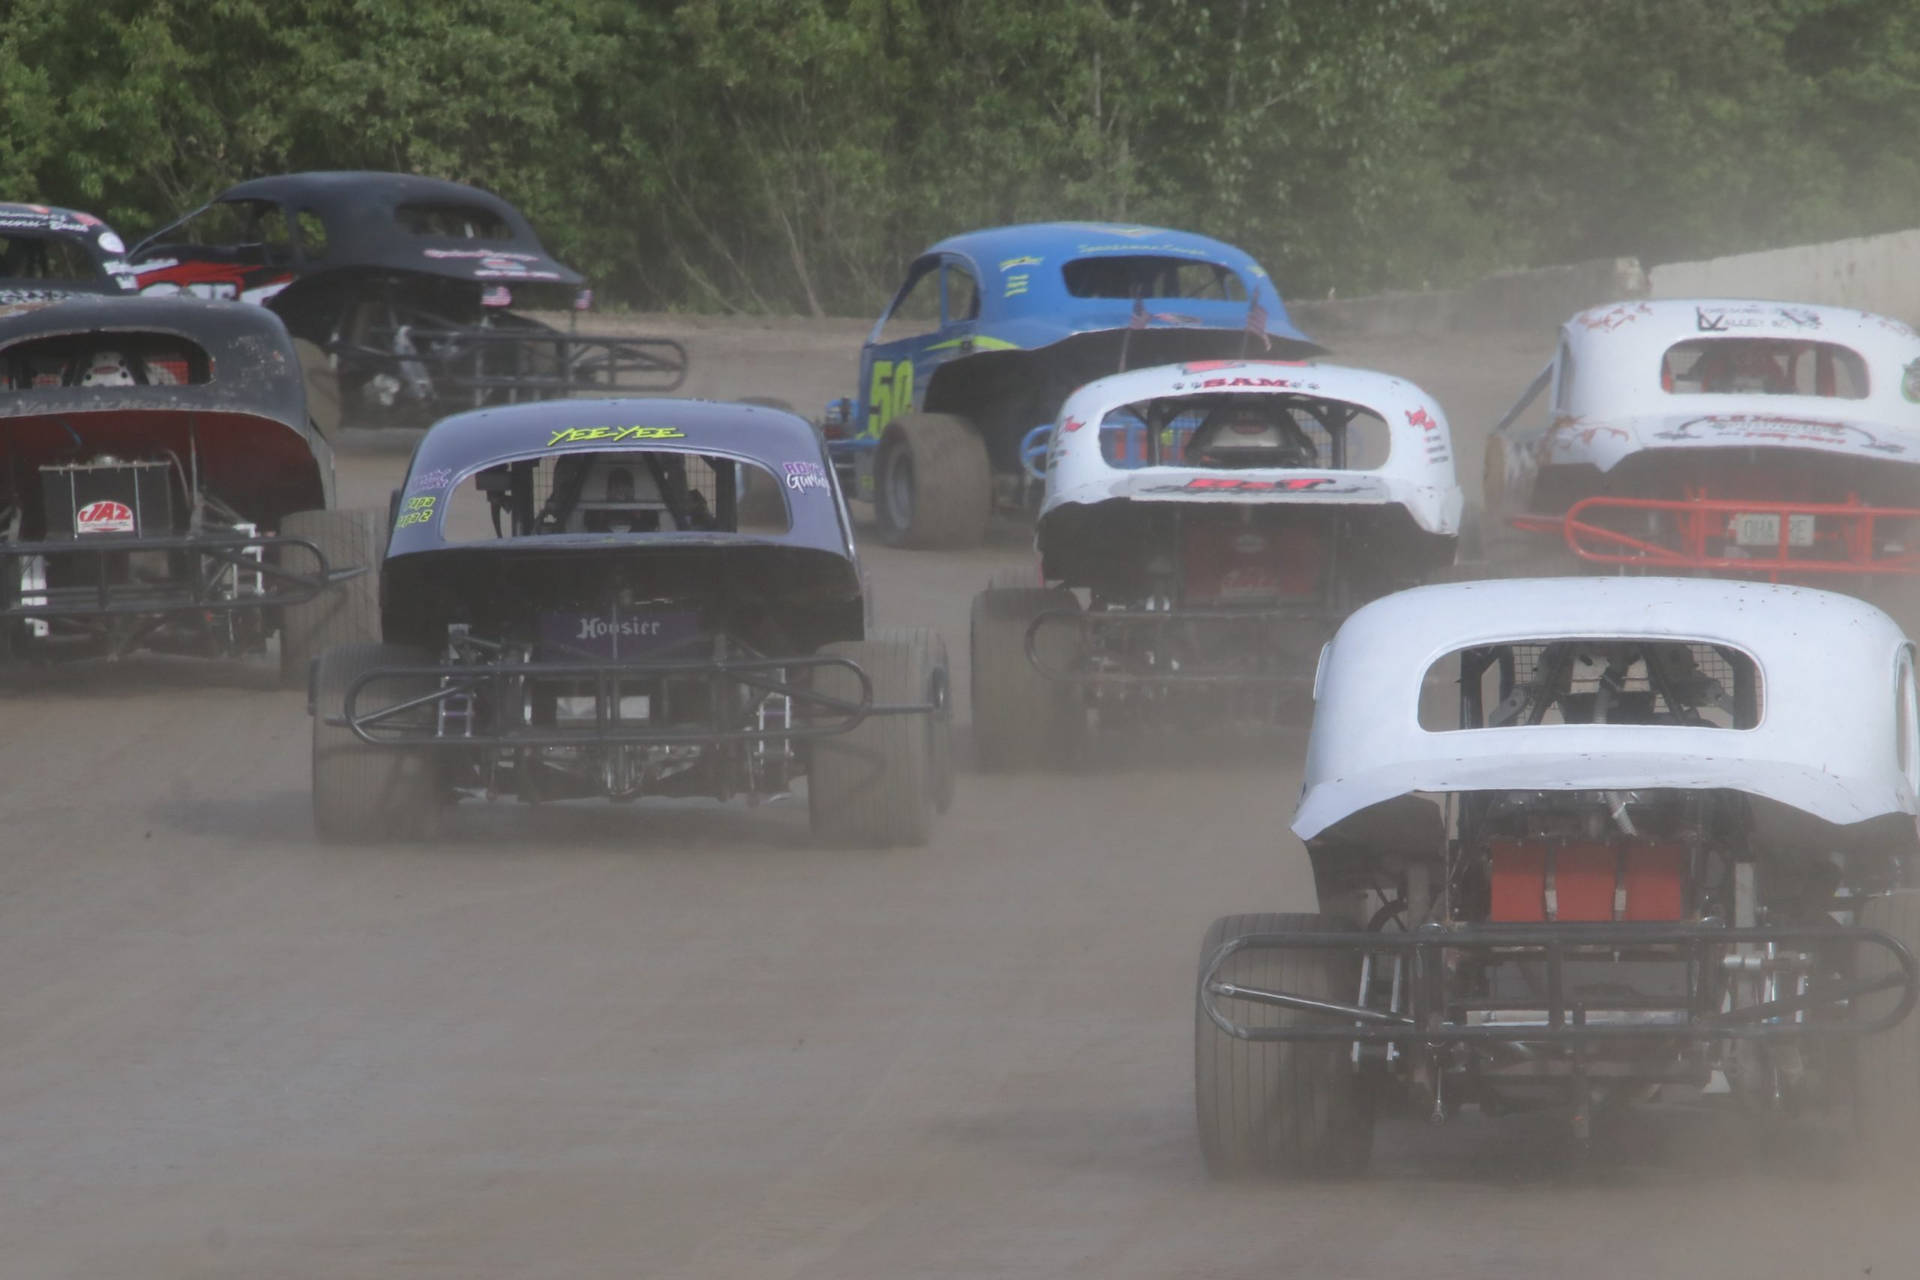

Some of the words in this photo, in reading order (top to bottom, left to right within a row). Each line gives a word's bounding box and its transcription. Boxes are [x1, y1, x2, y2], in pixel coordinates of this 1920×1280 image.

[1202, 377, 1290, 388] SAM
[866, 359, 914, 439] 50
[548, 425, 685, 446] YEE-YEE
[79, 502, 131, 522] JAZ
[576, 616, 661, 639] Hoosier
